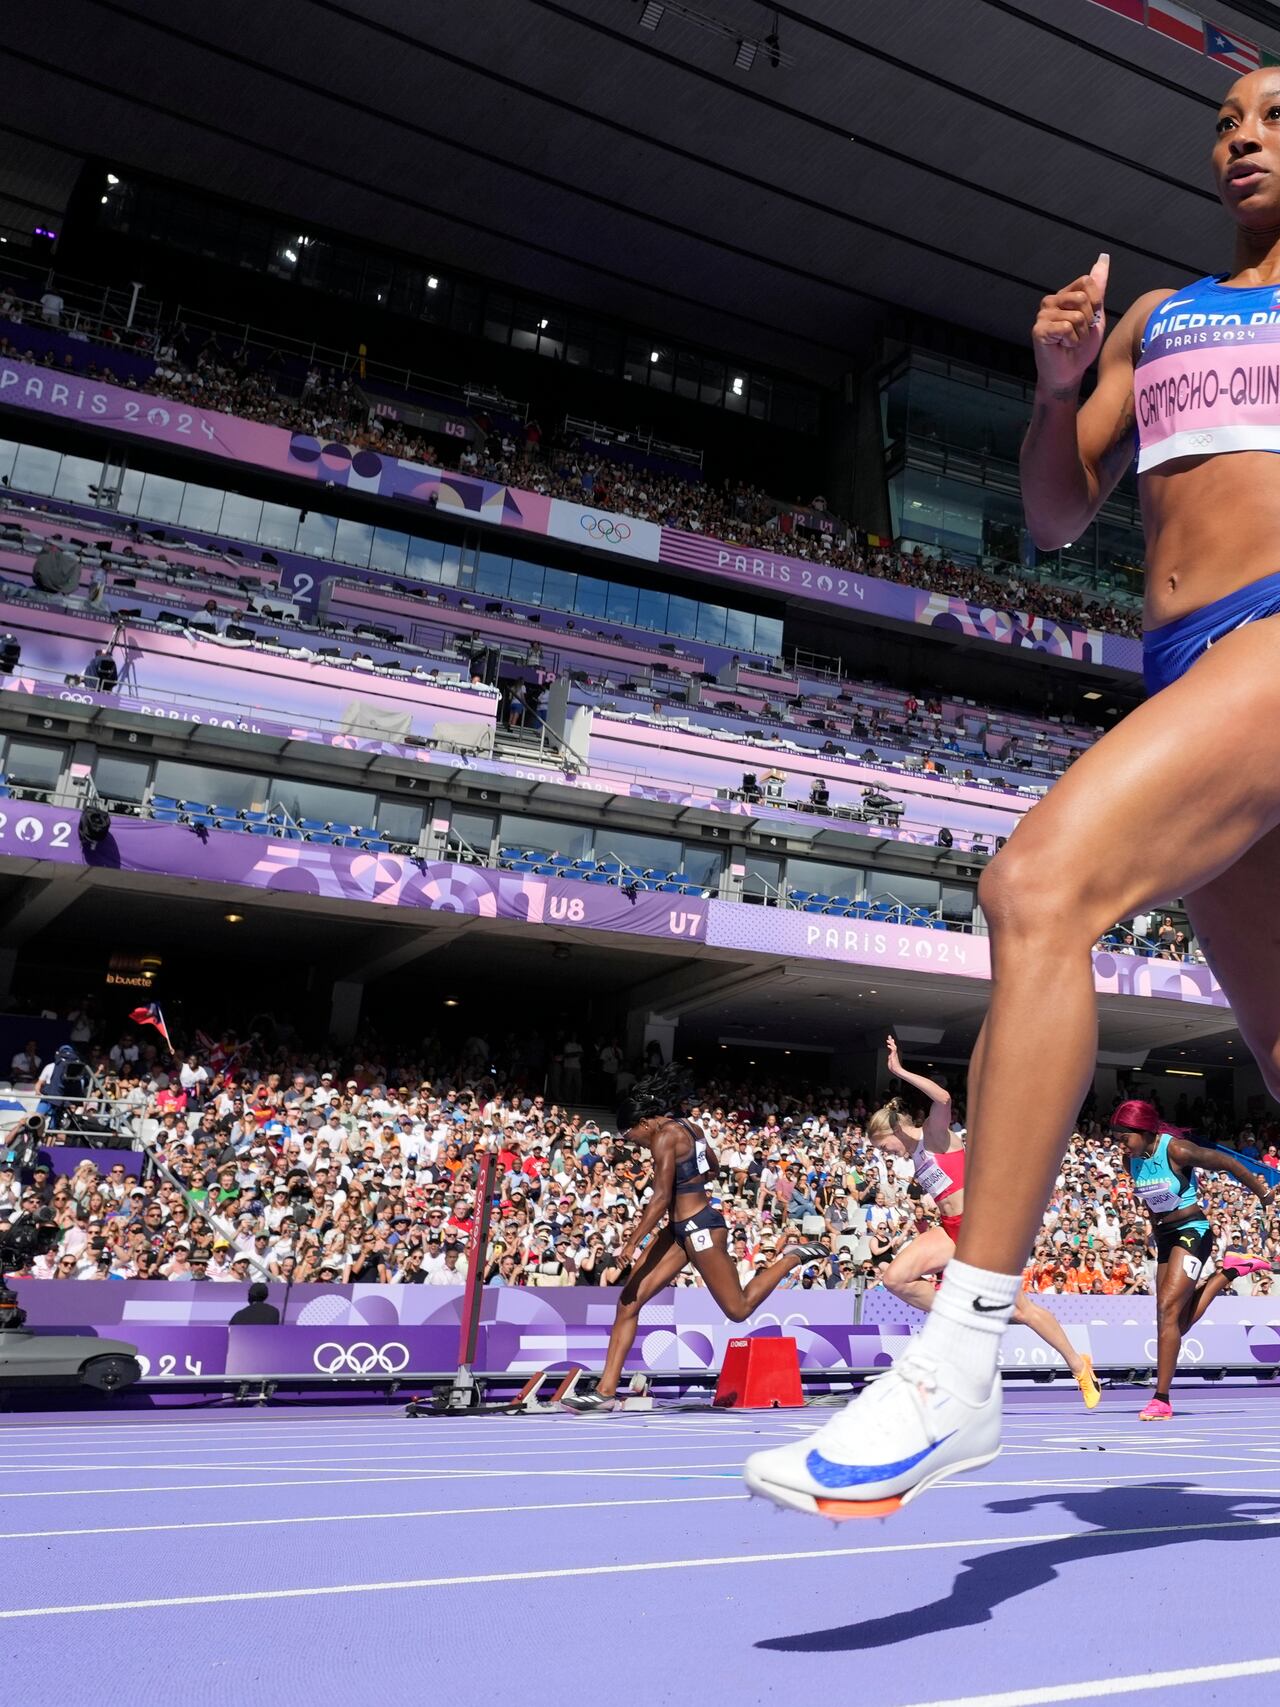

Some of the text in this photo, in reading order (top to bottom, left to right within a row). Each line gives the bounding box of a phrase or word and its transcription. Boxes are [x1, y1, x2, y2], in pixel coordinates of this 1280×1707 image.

[1166, 330, 1256, 349] PARIS 2024
[0, 369, 214, 440] PARIS 2024
[376, 403, 397, 420] U4
[445, 422, 466, 438] U3
[718, 550, 865, 600] PARIS 2024
[293, 573, 314, 603] 2
[44, 718, 52, 729] 9
[128, 733, 137, 743] 8
[409, 779, 416, 788] 7
[480, 790, 487, 800] 6
[712, 828, 719, 837] 5
[770, 837, 777, 846] 4
[966, 868, 972, 876] 3
[550, 896, 585, 921] U8
[669, 911, 702, 936] U7
[807, 925, 967, 965] PARIS 2024
[115, 973, 152, 987] buvette
[697, 1234, 706, 1246] 9
[1189, 1262, 1198, 1274] 7
